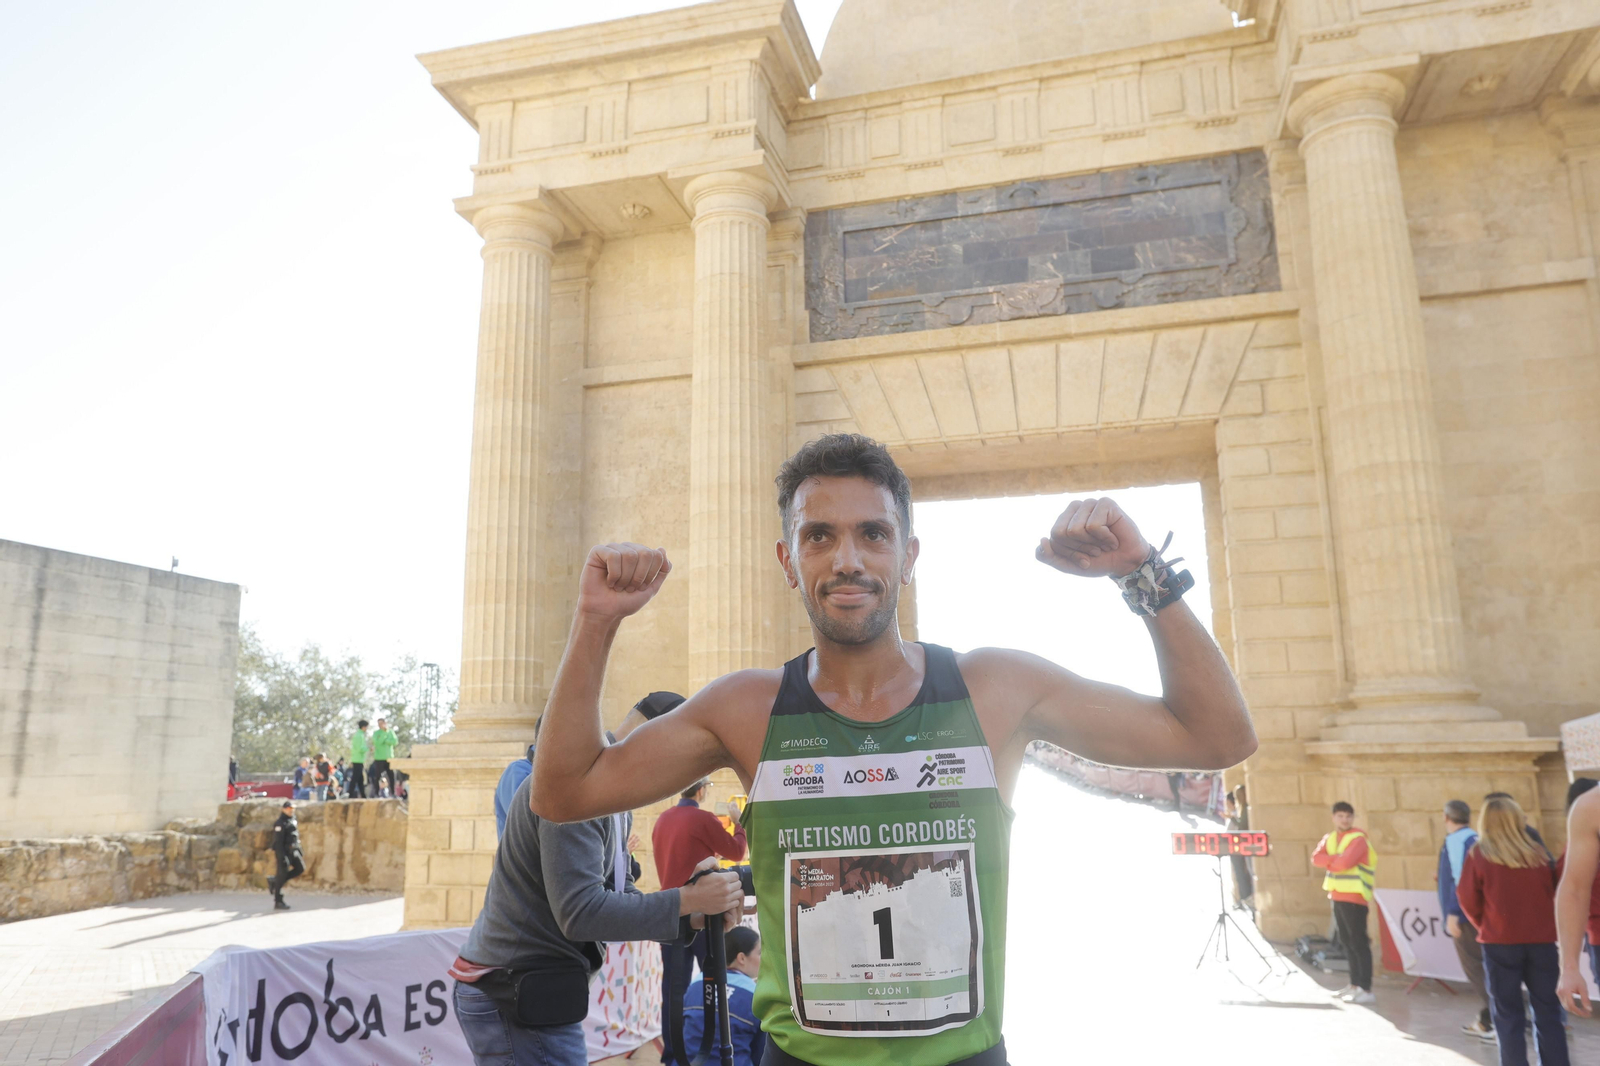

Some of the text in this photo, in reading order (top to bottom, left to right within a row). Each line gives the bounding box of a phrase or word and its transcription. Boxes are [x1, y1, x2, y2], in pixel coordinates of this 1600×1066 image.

[790, 737, 828, 747] IMDECO
[843, 767, 897, 784] AOSSA
[949, 767, 966, 775] SPORT
[783, 776, 824, 787] CÓRDOBA
[938, 775, 963, 786] CAC
[778, 815, 977, 849] ATLETISMO CORDOBÉS
[1172, 833, 1268, 856] 01:07:29
[808, 873, 835, 881] MARATÓN
[872, 906, 895, 960] 1
[867, 985, 910, 996] CAJÓN 1
[403, 979, 448, 1033] ES
